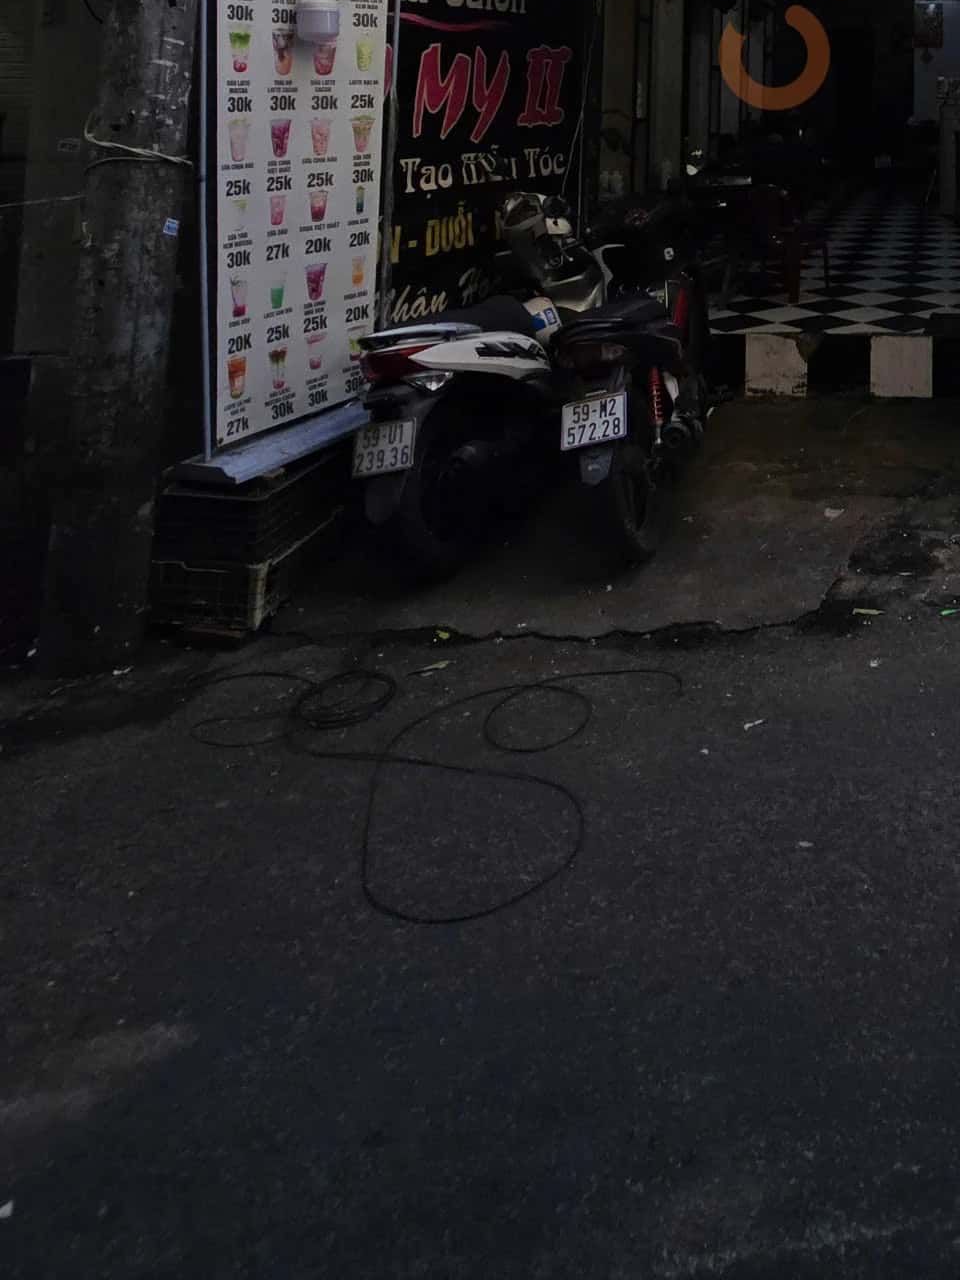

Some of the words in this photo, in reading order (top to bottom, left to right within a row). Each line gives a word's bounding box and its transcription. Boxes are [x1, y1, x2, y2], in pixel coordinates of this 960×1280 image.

[516, 45, 574, 128] II
[400, 157, 453, 199] Tạo
[523, 146, 567, 178] Tóc
[567, 417, 621, 446] 572.28
